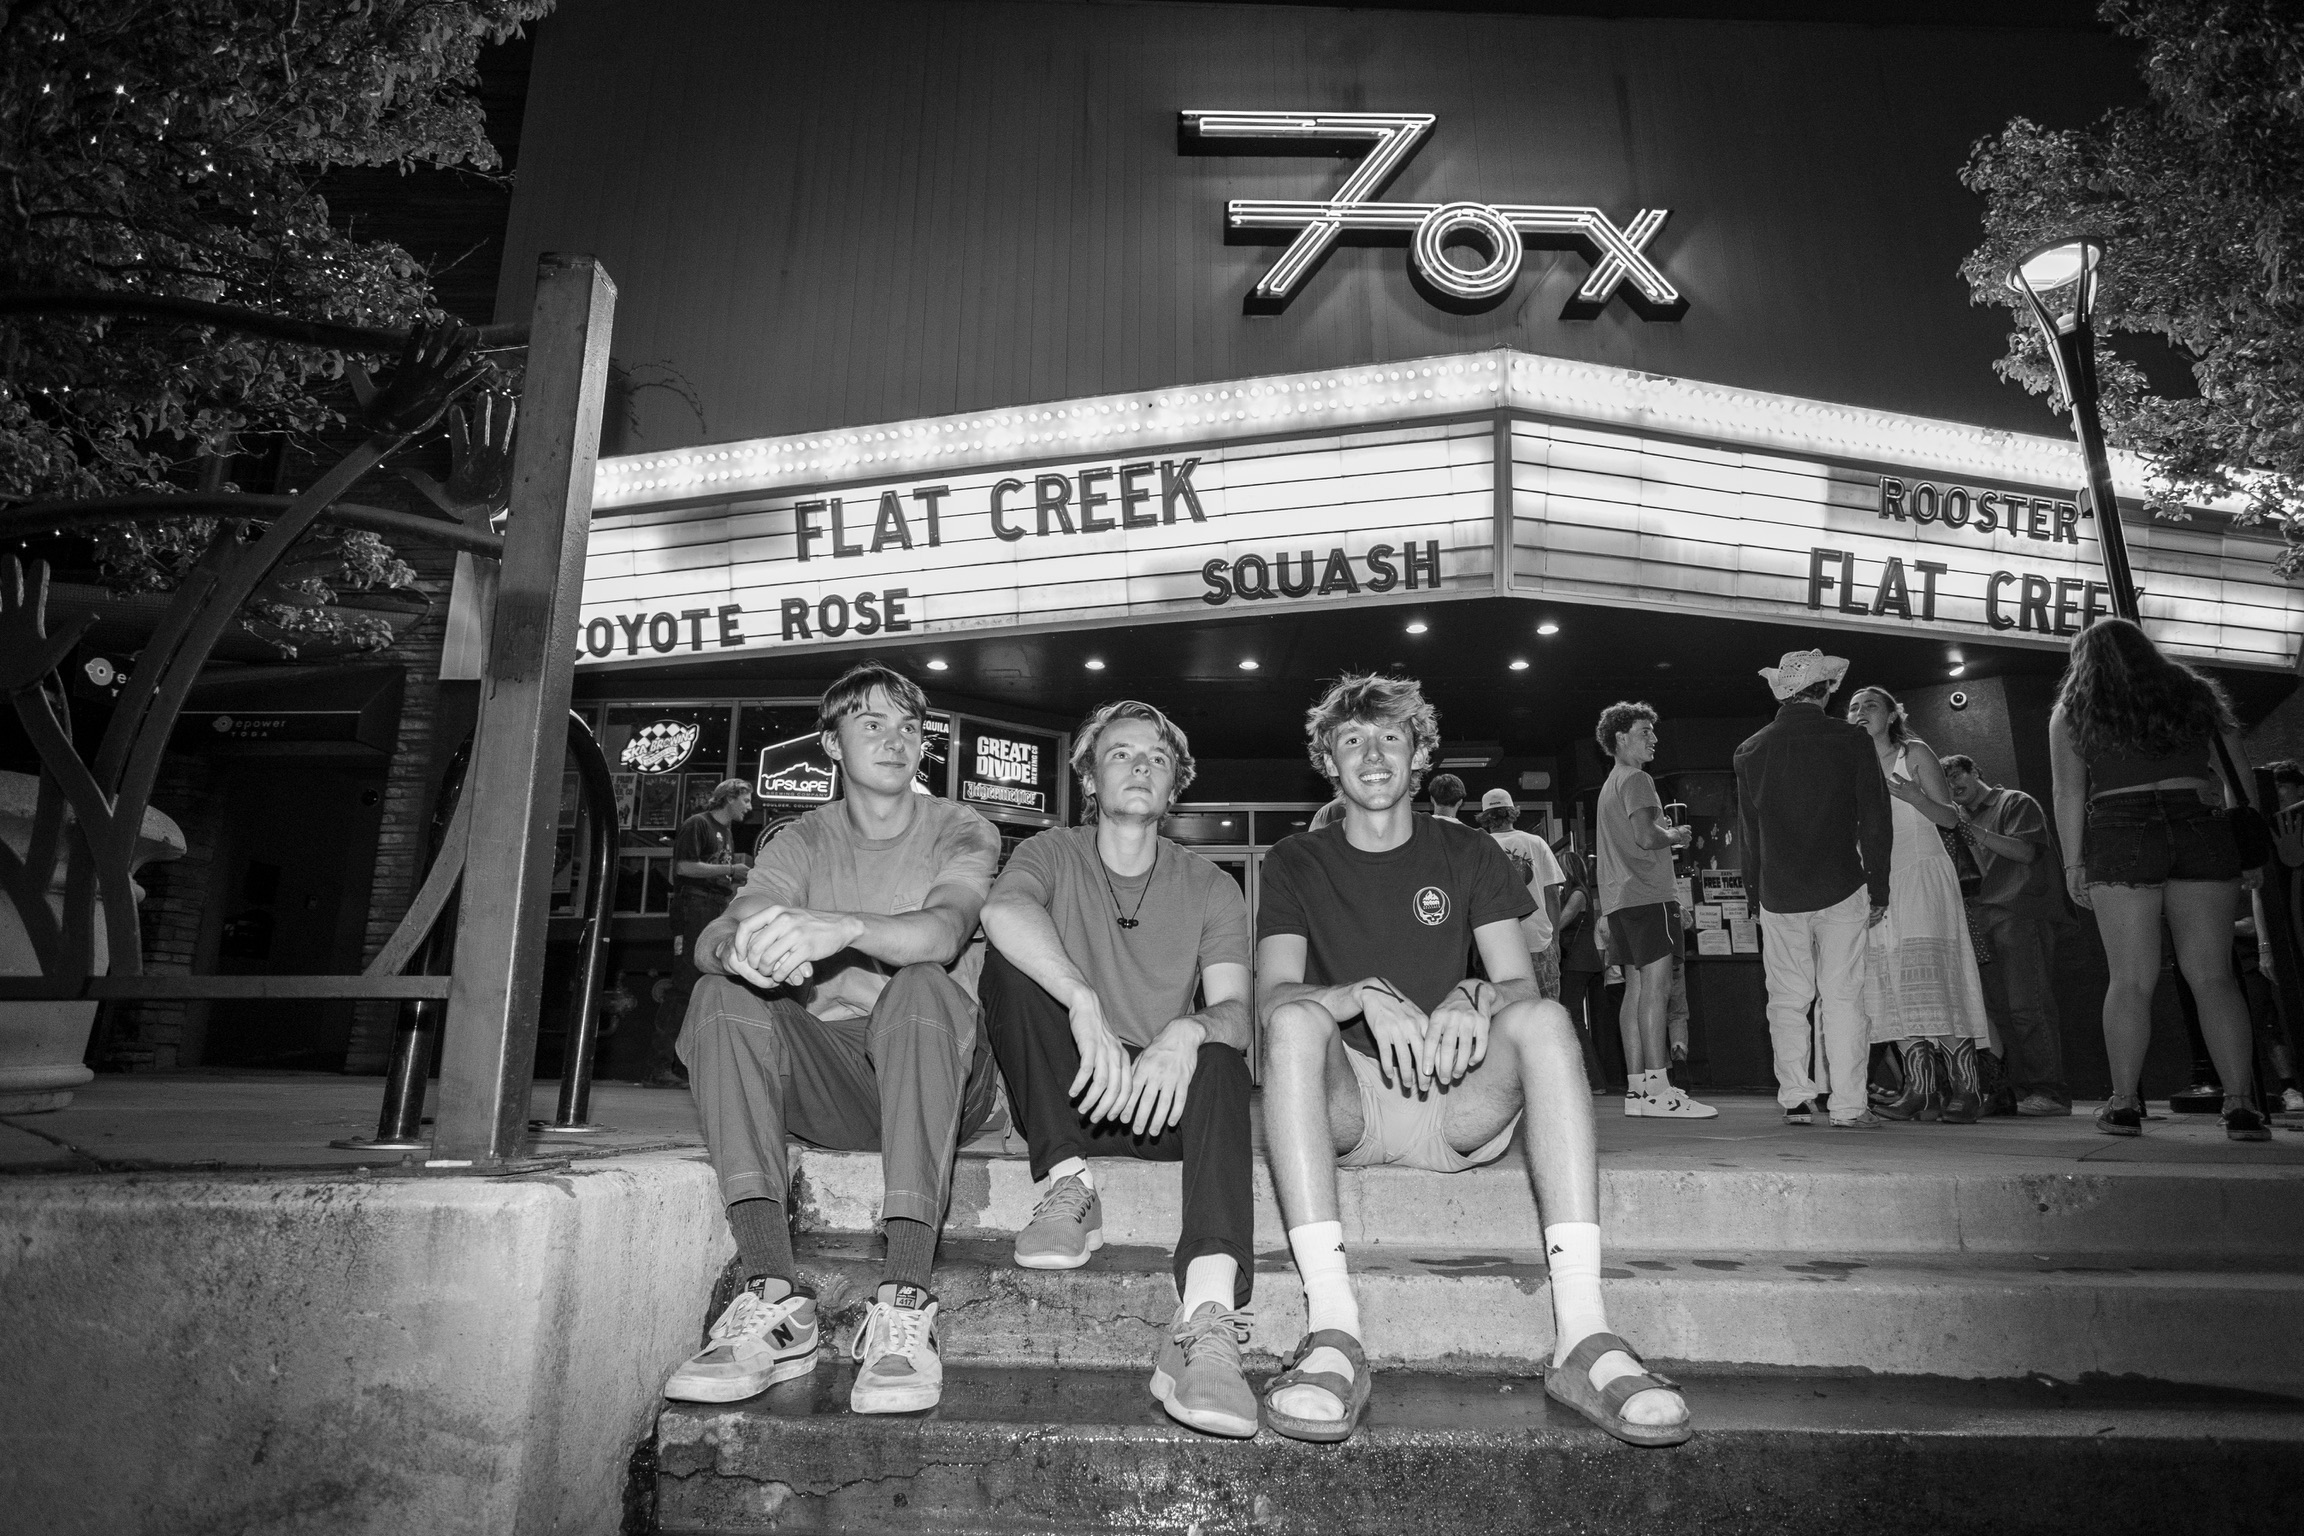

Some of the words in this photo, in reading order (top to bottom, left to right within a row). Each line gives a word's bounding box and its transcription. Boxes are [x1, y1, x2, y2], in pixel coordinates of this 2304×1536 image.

[795, 484, 951, 562] FLAT
[990, 457, 1208, 543] CREEK
[1878, 475, 2079, 545] ROOSTER
[1201, 539, 1442, 606] SQUASH
[1807, 547, 1947, 621] FLAT
[1986, 570, 2146, 636] CREE
[575, 603, 745, 661] OYOTE
[780, 588, 911, 641] ROSE
[621, 743, 648, 763] SKA
[976, 735, 1031, 762] GREAT
[976, 755, 1031, 784] DIVIDE
[765, 778, 829, 793] UPSLOPE
[1703, 876, 1721, 889] FREE
[1722, 876, 1743, 889] TICKE
[899, 1298, 913, 1306] 417
[771, 1322, 795, 1349] N
